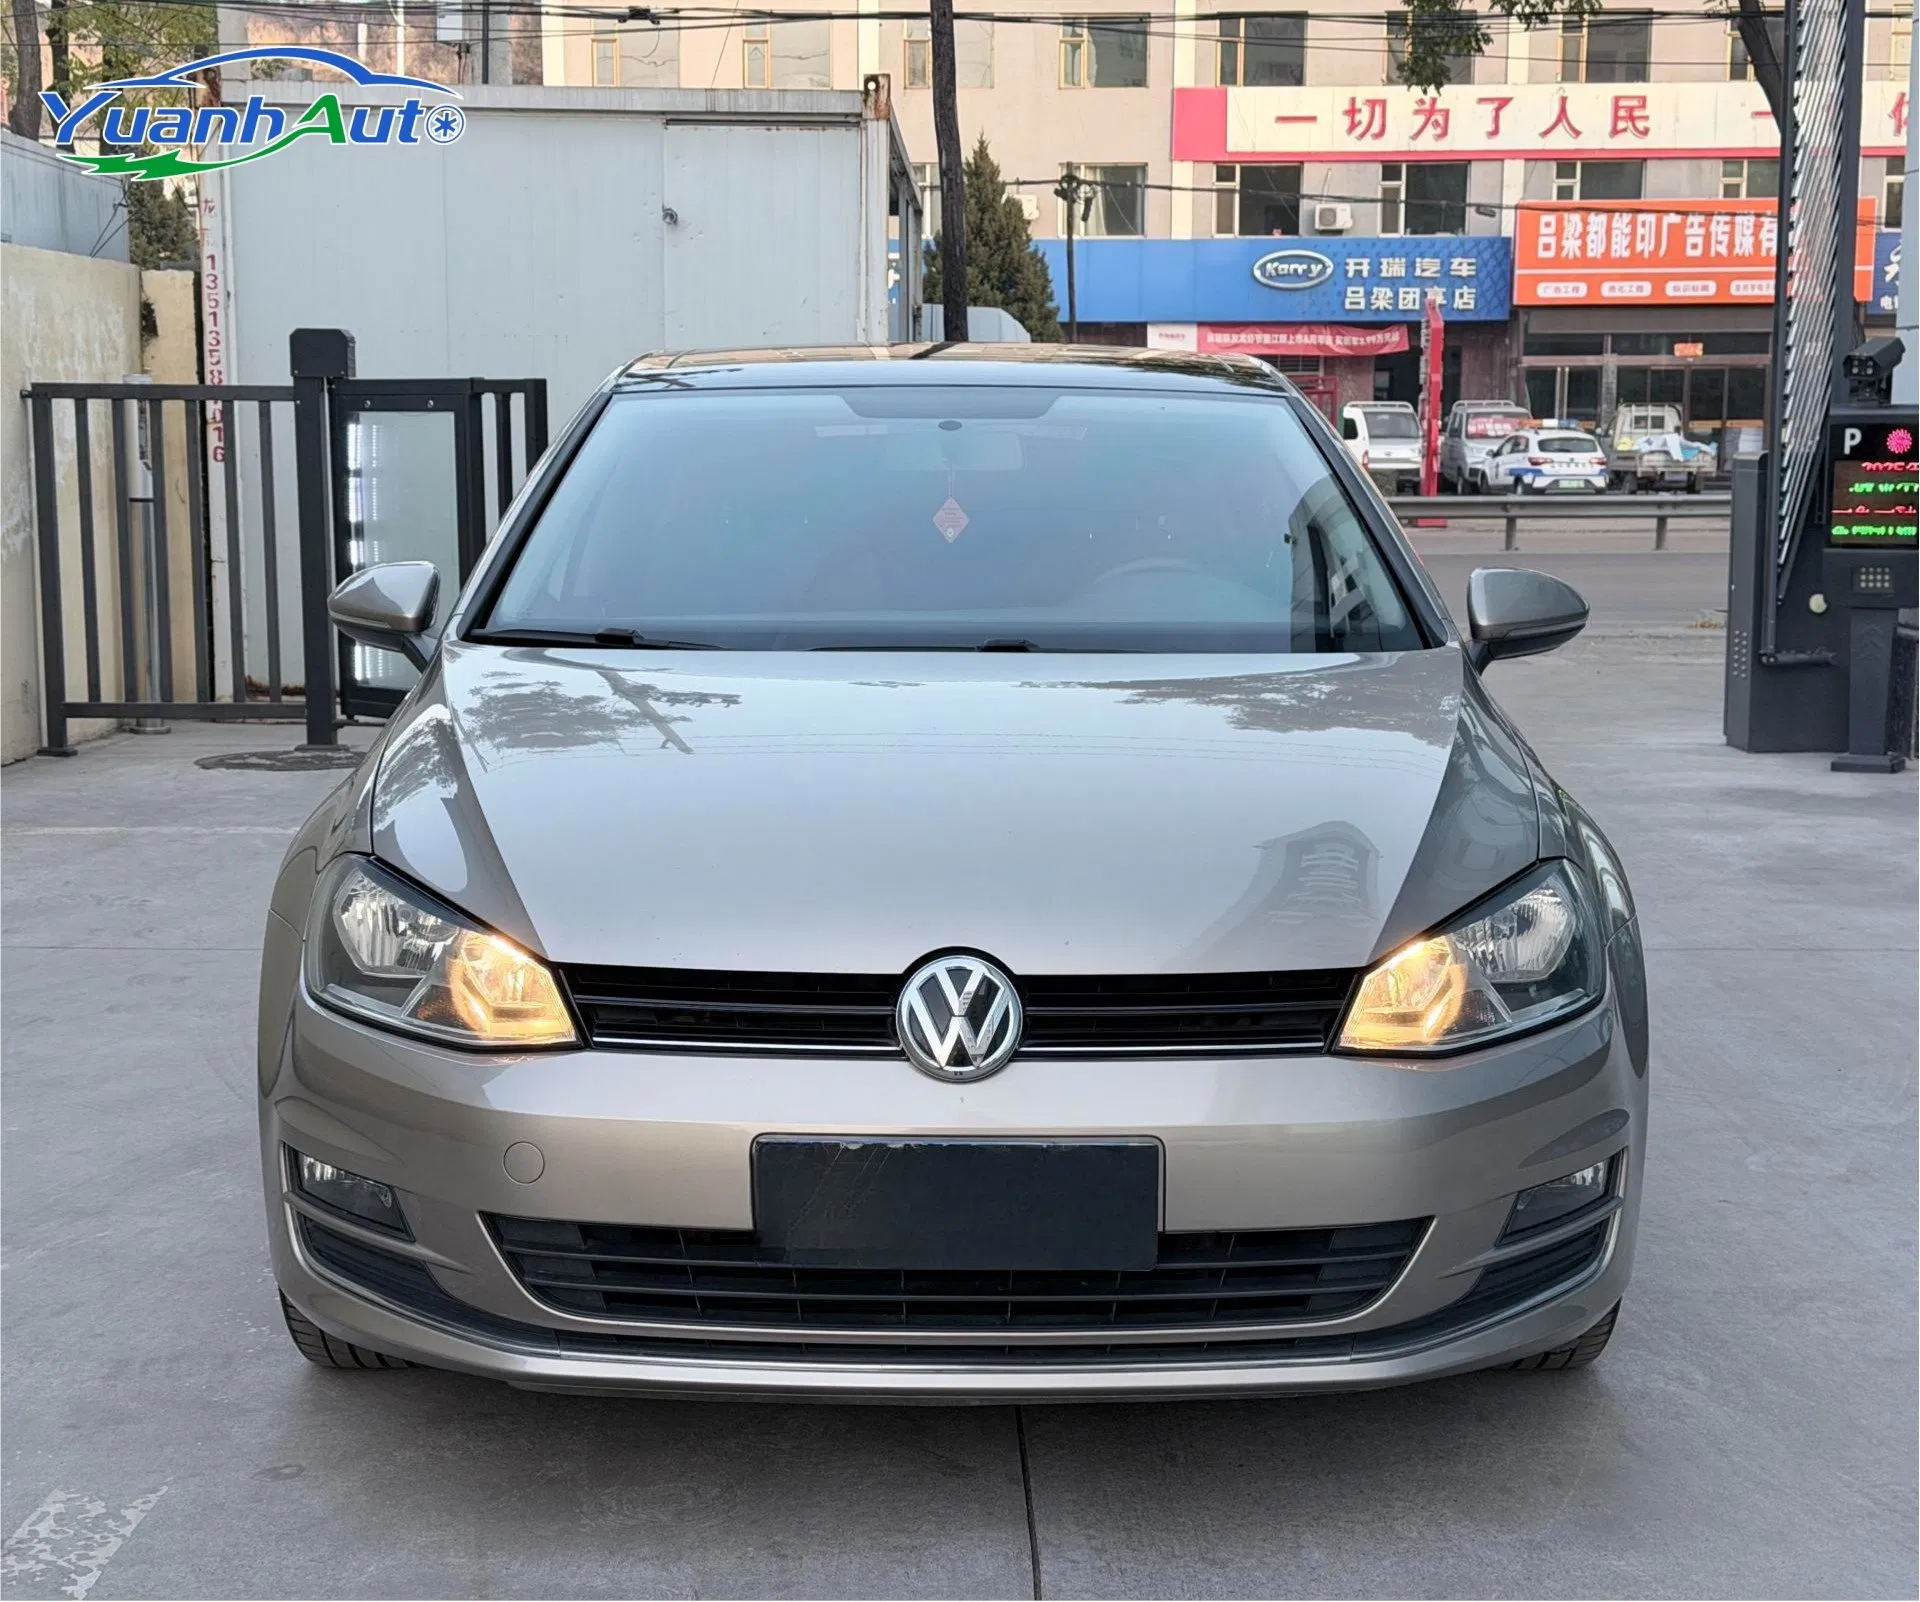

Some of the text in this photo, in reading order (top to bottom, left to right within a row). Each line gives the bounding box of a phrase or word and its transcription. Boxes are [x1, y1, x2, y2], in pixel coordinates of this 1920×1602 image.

[1275, 95, 1650, 142] 一切为了人民
[1265, 261, 1324, 278] Karry
[1344, 257, 1477, 279] 开瑞汽车
[1843, 427, 1863, 456] P
[898, 956, 1020, 1078] VW
